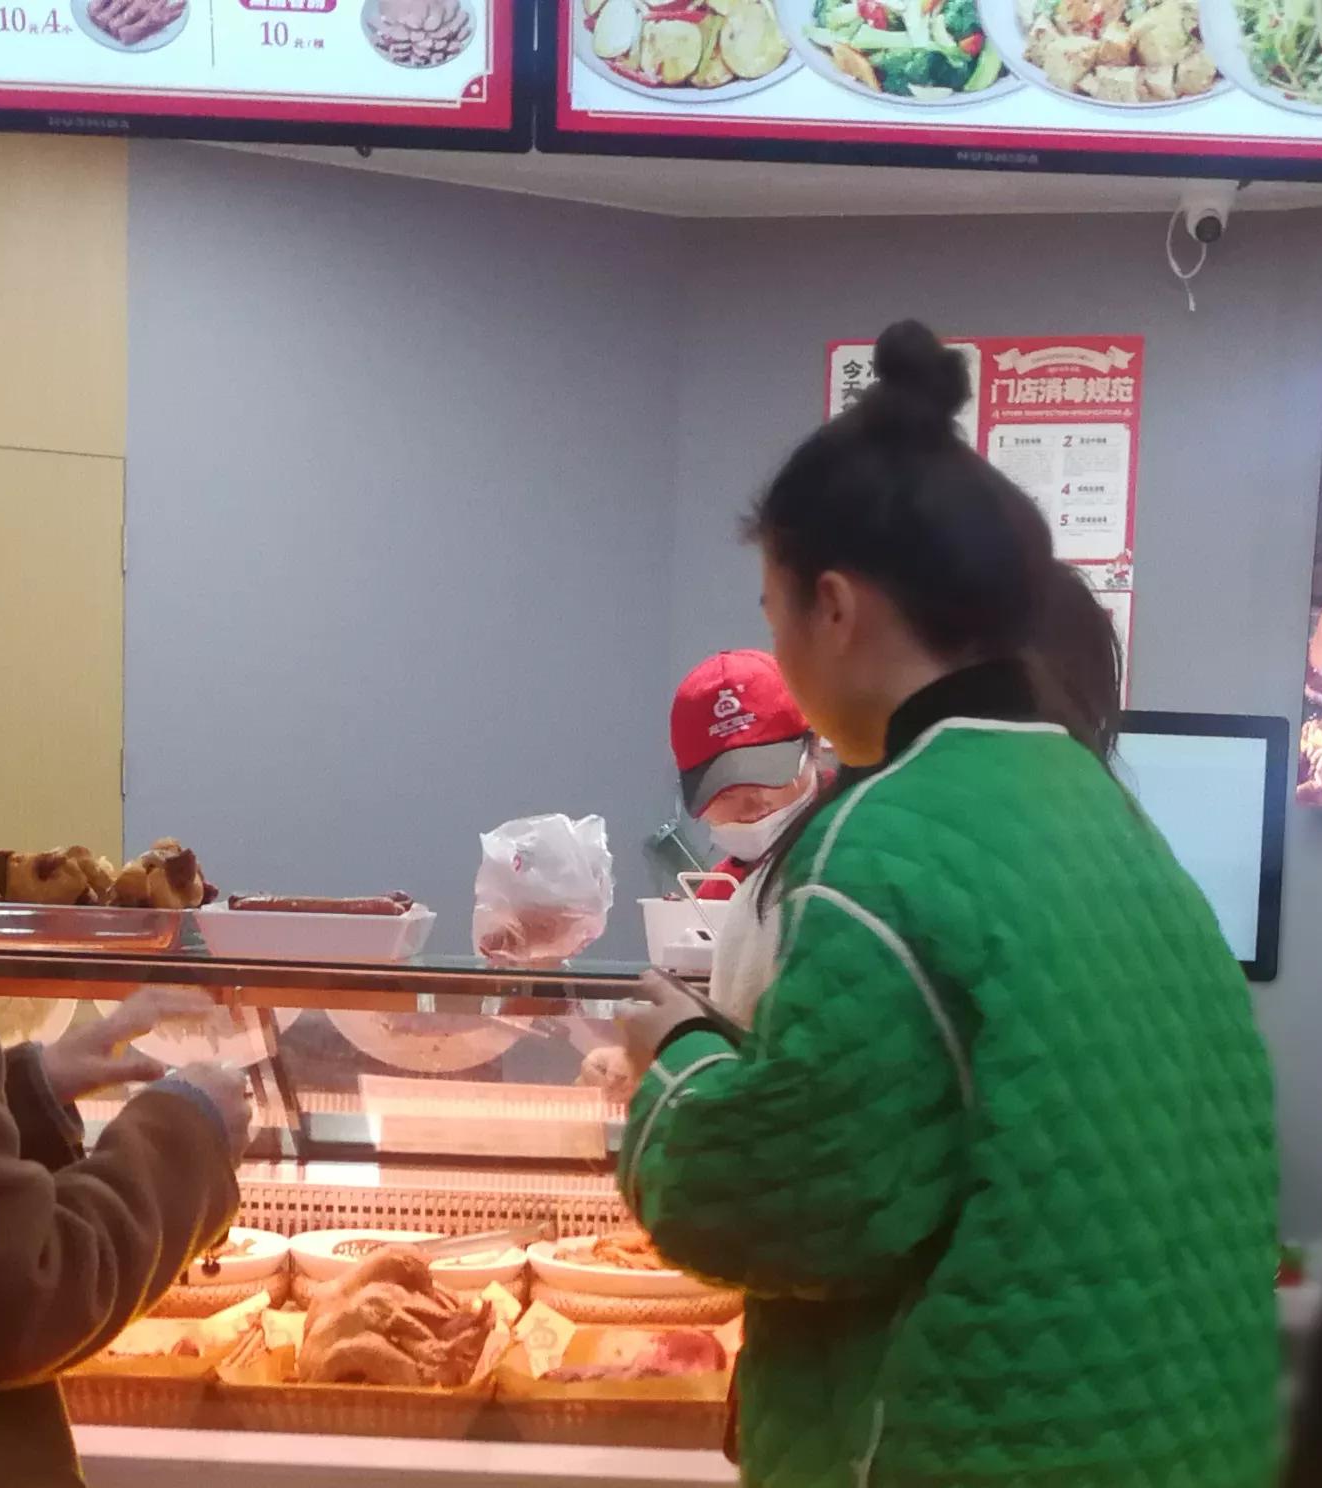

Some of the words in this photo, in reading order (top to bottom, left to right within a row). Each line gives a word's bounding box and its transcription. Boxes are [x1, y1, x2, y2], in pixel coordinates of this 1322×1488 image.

[990, 376, 1135, 405] 门店消毒规范
[1062, 435, 1073, 447] 2
[1061, 483, 1071, 496] 4
[1059, 514, 1069, 527] 5
